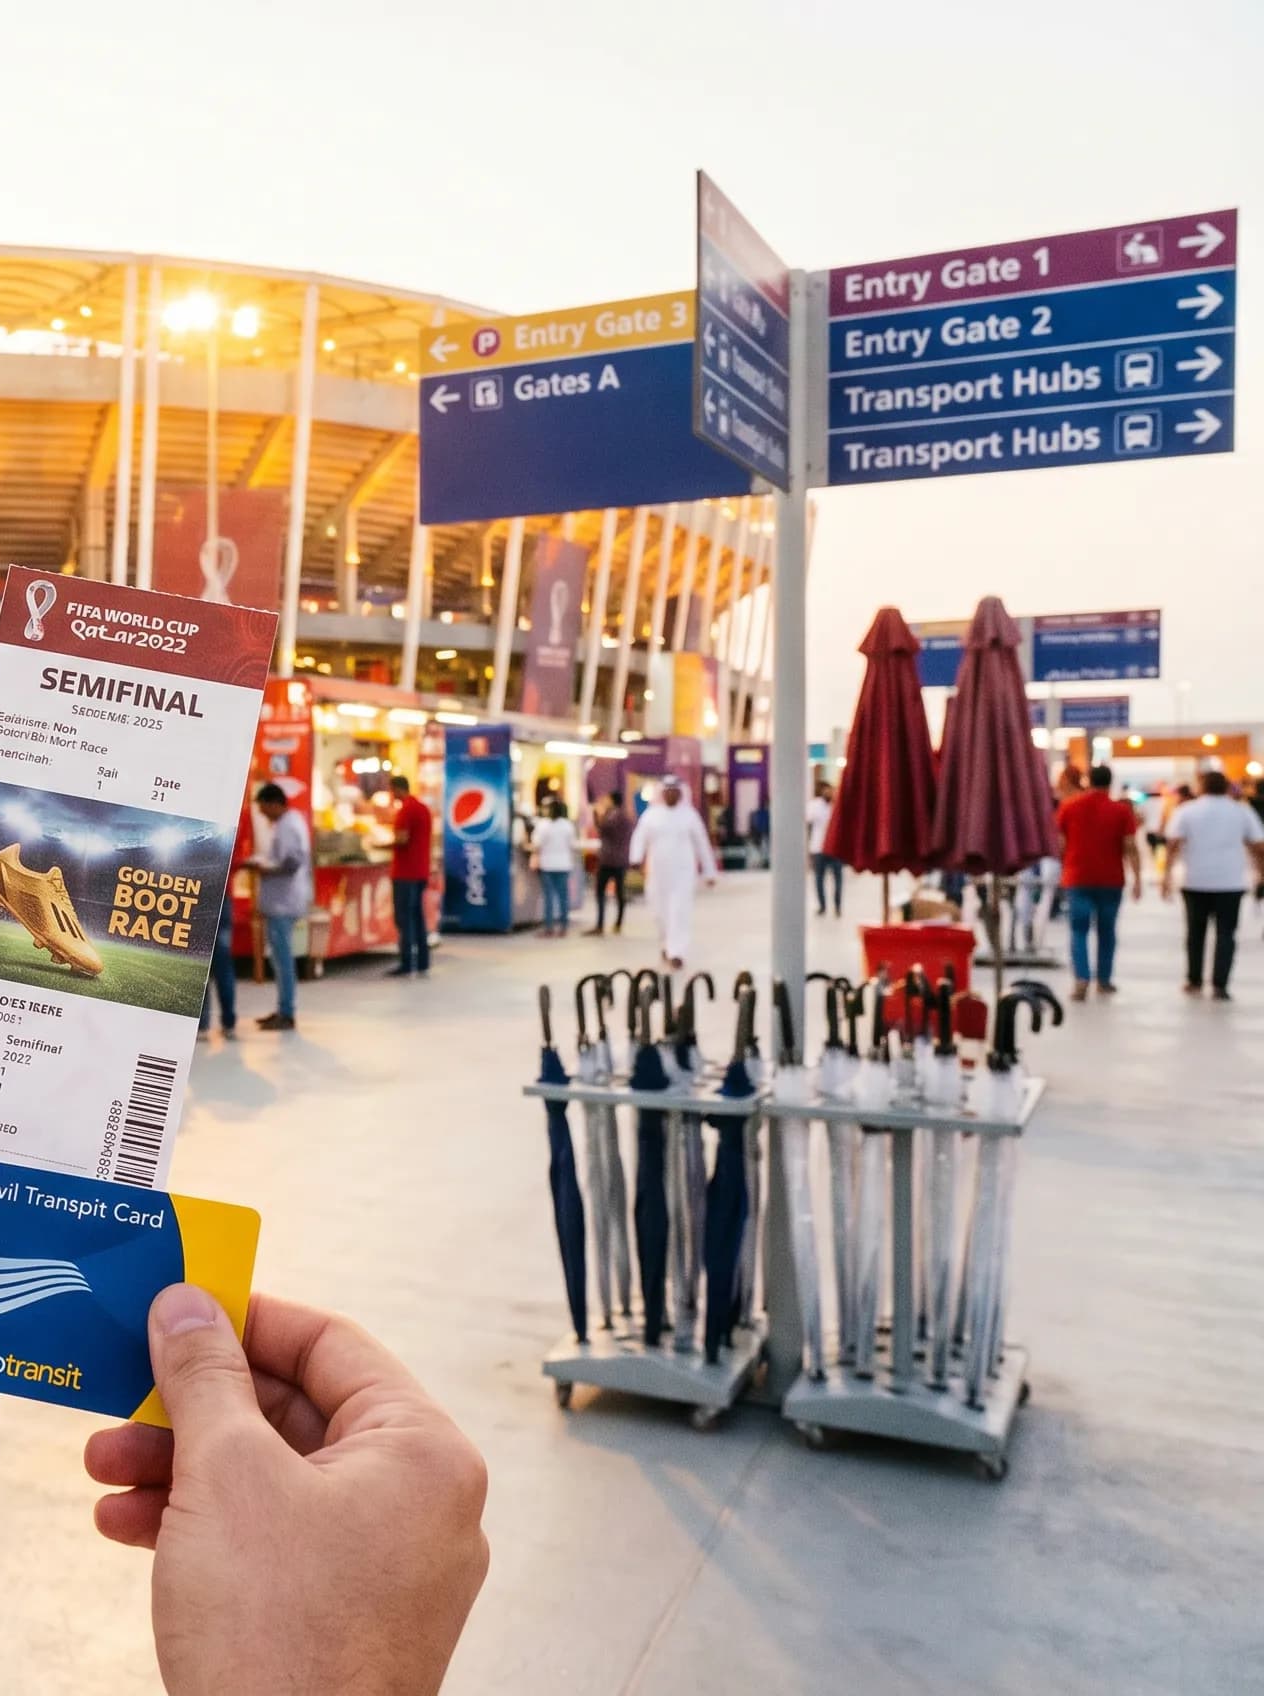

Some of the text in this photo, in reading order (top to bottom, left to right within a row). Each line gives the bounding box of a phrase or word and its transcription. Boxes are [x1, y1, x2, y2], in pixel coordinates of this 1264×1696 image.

[845, 247, 1050, 302] Entry Gate 1
[514, 322, 586, 350] Entry
[595, 310, 662, 338] Gate
[670, 301, 687, 328] 3
[845, 306, 1052, 359] Entry Gate 2
[514, 364, 620, 401] Gates A
[844, 361, 1101, 414] Transport Hubs
[843, 422, 1101, 471] Transport Hubs
[66, 602, 200, 637] FIFA WORLD CUP
[40, 667, 205, 719] SEMIFINAL
[133, 716, 164, 731] 2025
[80, 741, 108, 756] Race
[154, 776, 181, 791] Date
[118, 866, 202, 896] GOLDEN
[113, 884, 198, 920] BOOT
[107, 910, 192, 949] RACE
[2, 1050, 32, 1065] 2022
[25, 1185, 107, 1220] Transpit
[113, 1203, 164, 1229] Card
